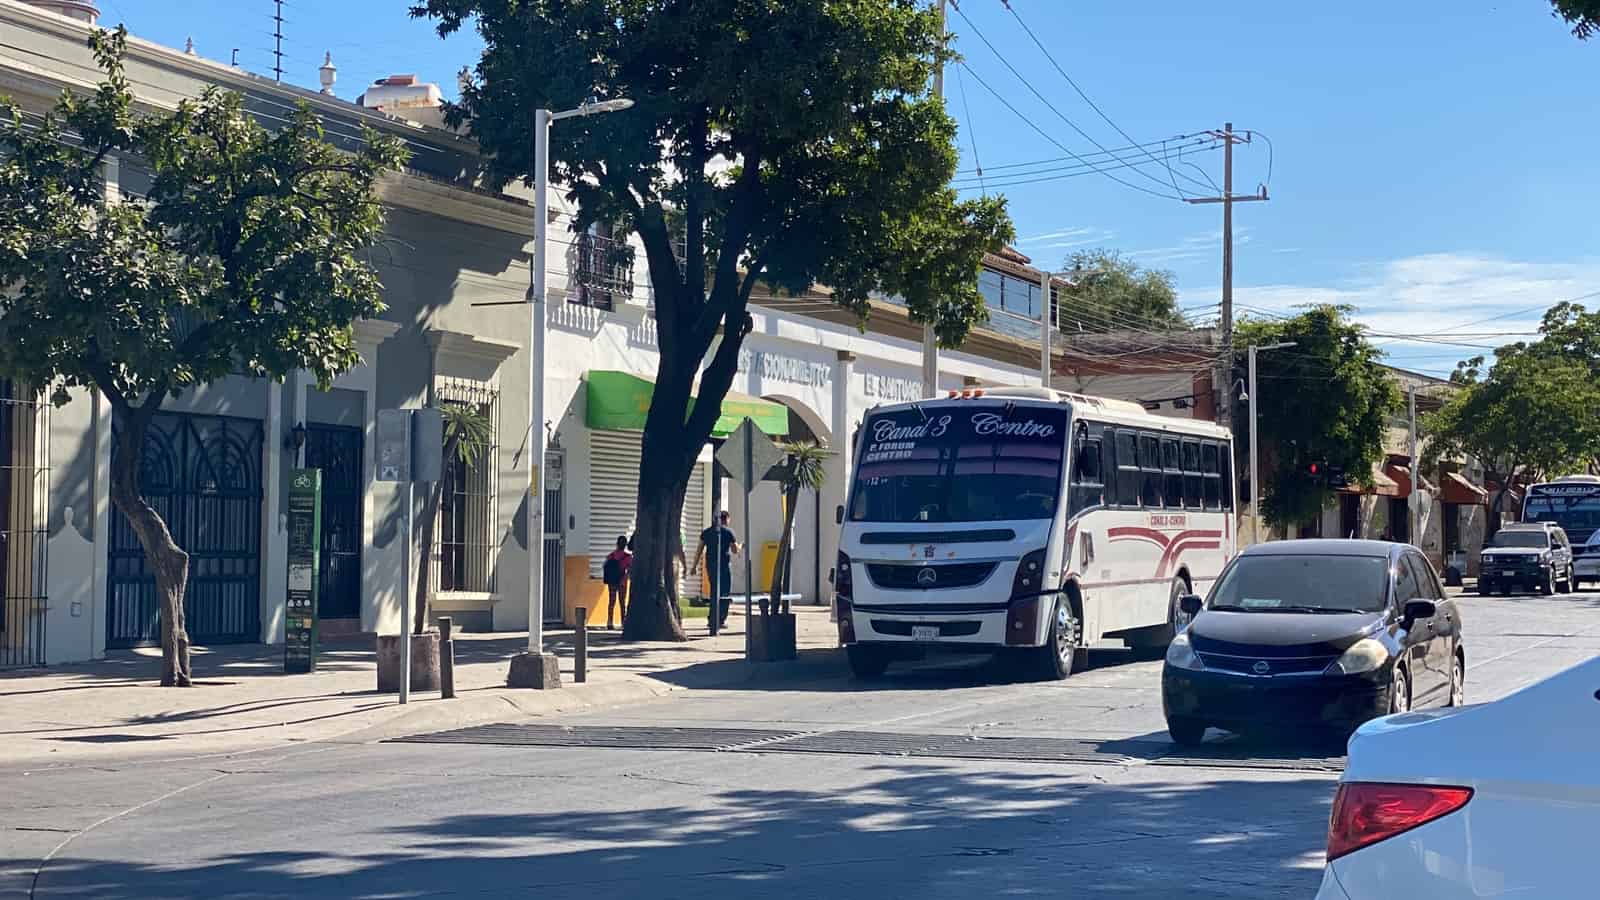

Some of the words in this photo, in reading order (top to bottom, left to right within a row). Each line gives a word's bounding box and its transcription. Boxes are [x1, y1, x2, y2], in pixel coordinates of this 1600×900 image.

[872, 416, 935, 442] Canal
[930, 415, 952, 437] 3
[971, 412, 1056, 437] Centro
[878, 441, 915, 451] FORUM
[866, 450, 912, 462] CENTRO
